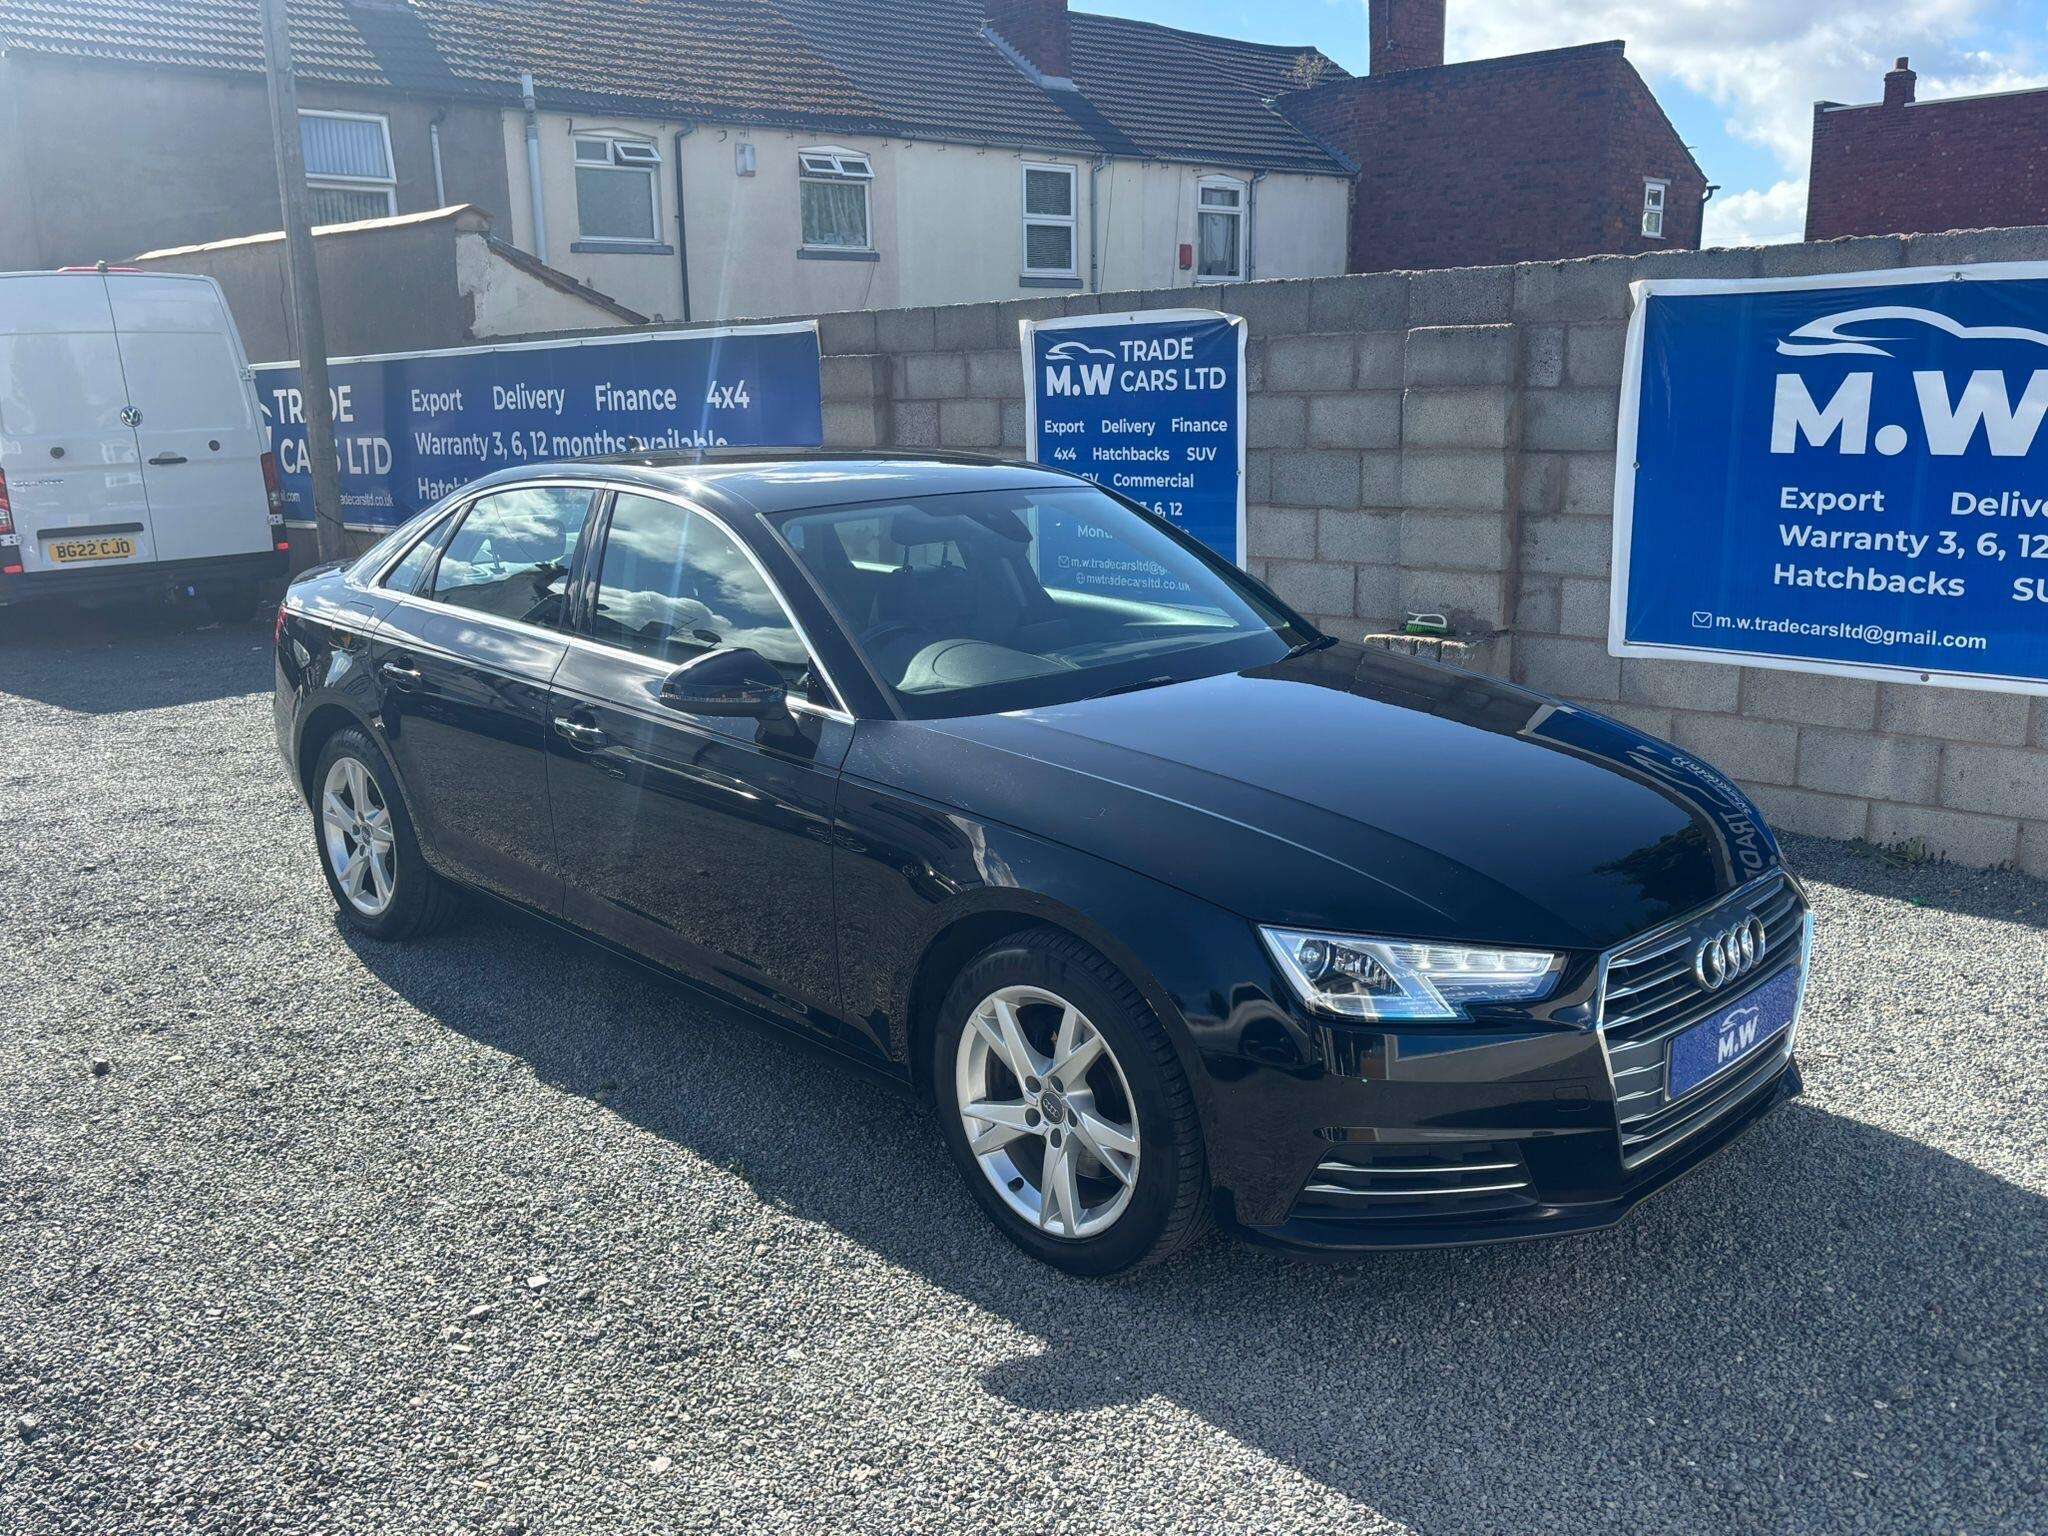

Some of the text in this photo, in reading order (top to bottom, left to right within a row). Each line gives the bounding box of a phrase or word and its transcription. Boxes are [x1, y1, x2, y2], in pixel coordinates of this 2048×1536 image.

[1119, 337, 1194, 362] TRADE
[1045, 364, 1115, 397] M.W
[1119, 367, 1227, 392] CARS LTD
[272, 385, 354, 425] TRE
[411, 379, 750, 417] Export Delivery Finance 4x4
[1769, 369, 2048, 457] M.W
[1044, 417, 1229, 437] Export Delivery Finance
[346, 437, 393, 475] LTD
[414, 431, 489, 462] Warranty
[492, 431, 508, 461] 3,
[511, 430, 528, 461] 6,
[529, 430, 549, 456] 12
[552, 429, 627, 458] months
[1053, 447, 1218, 462] 4x4 Hatchbacks SUV
[1113, 473, 1194, 489] Commercial
[1154, 501, 1166, 518] 6,
[1170, 501, 1183, 516] 12
[1779, 486, 1885, 516] Export
[56, 543, 98, 559] BG22
[1778, 524, 2048, 562] Warranty 3, 6, 12
[1773, 563, 1966, 597] Hatchbacks
[1715, 615, 1988, 650] m.w.tradecarsltd@gmail.com
[1717, 1014, 1760, 1065] M.W
